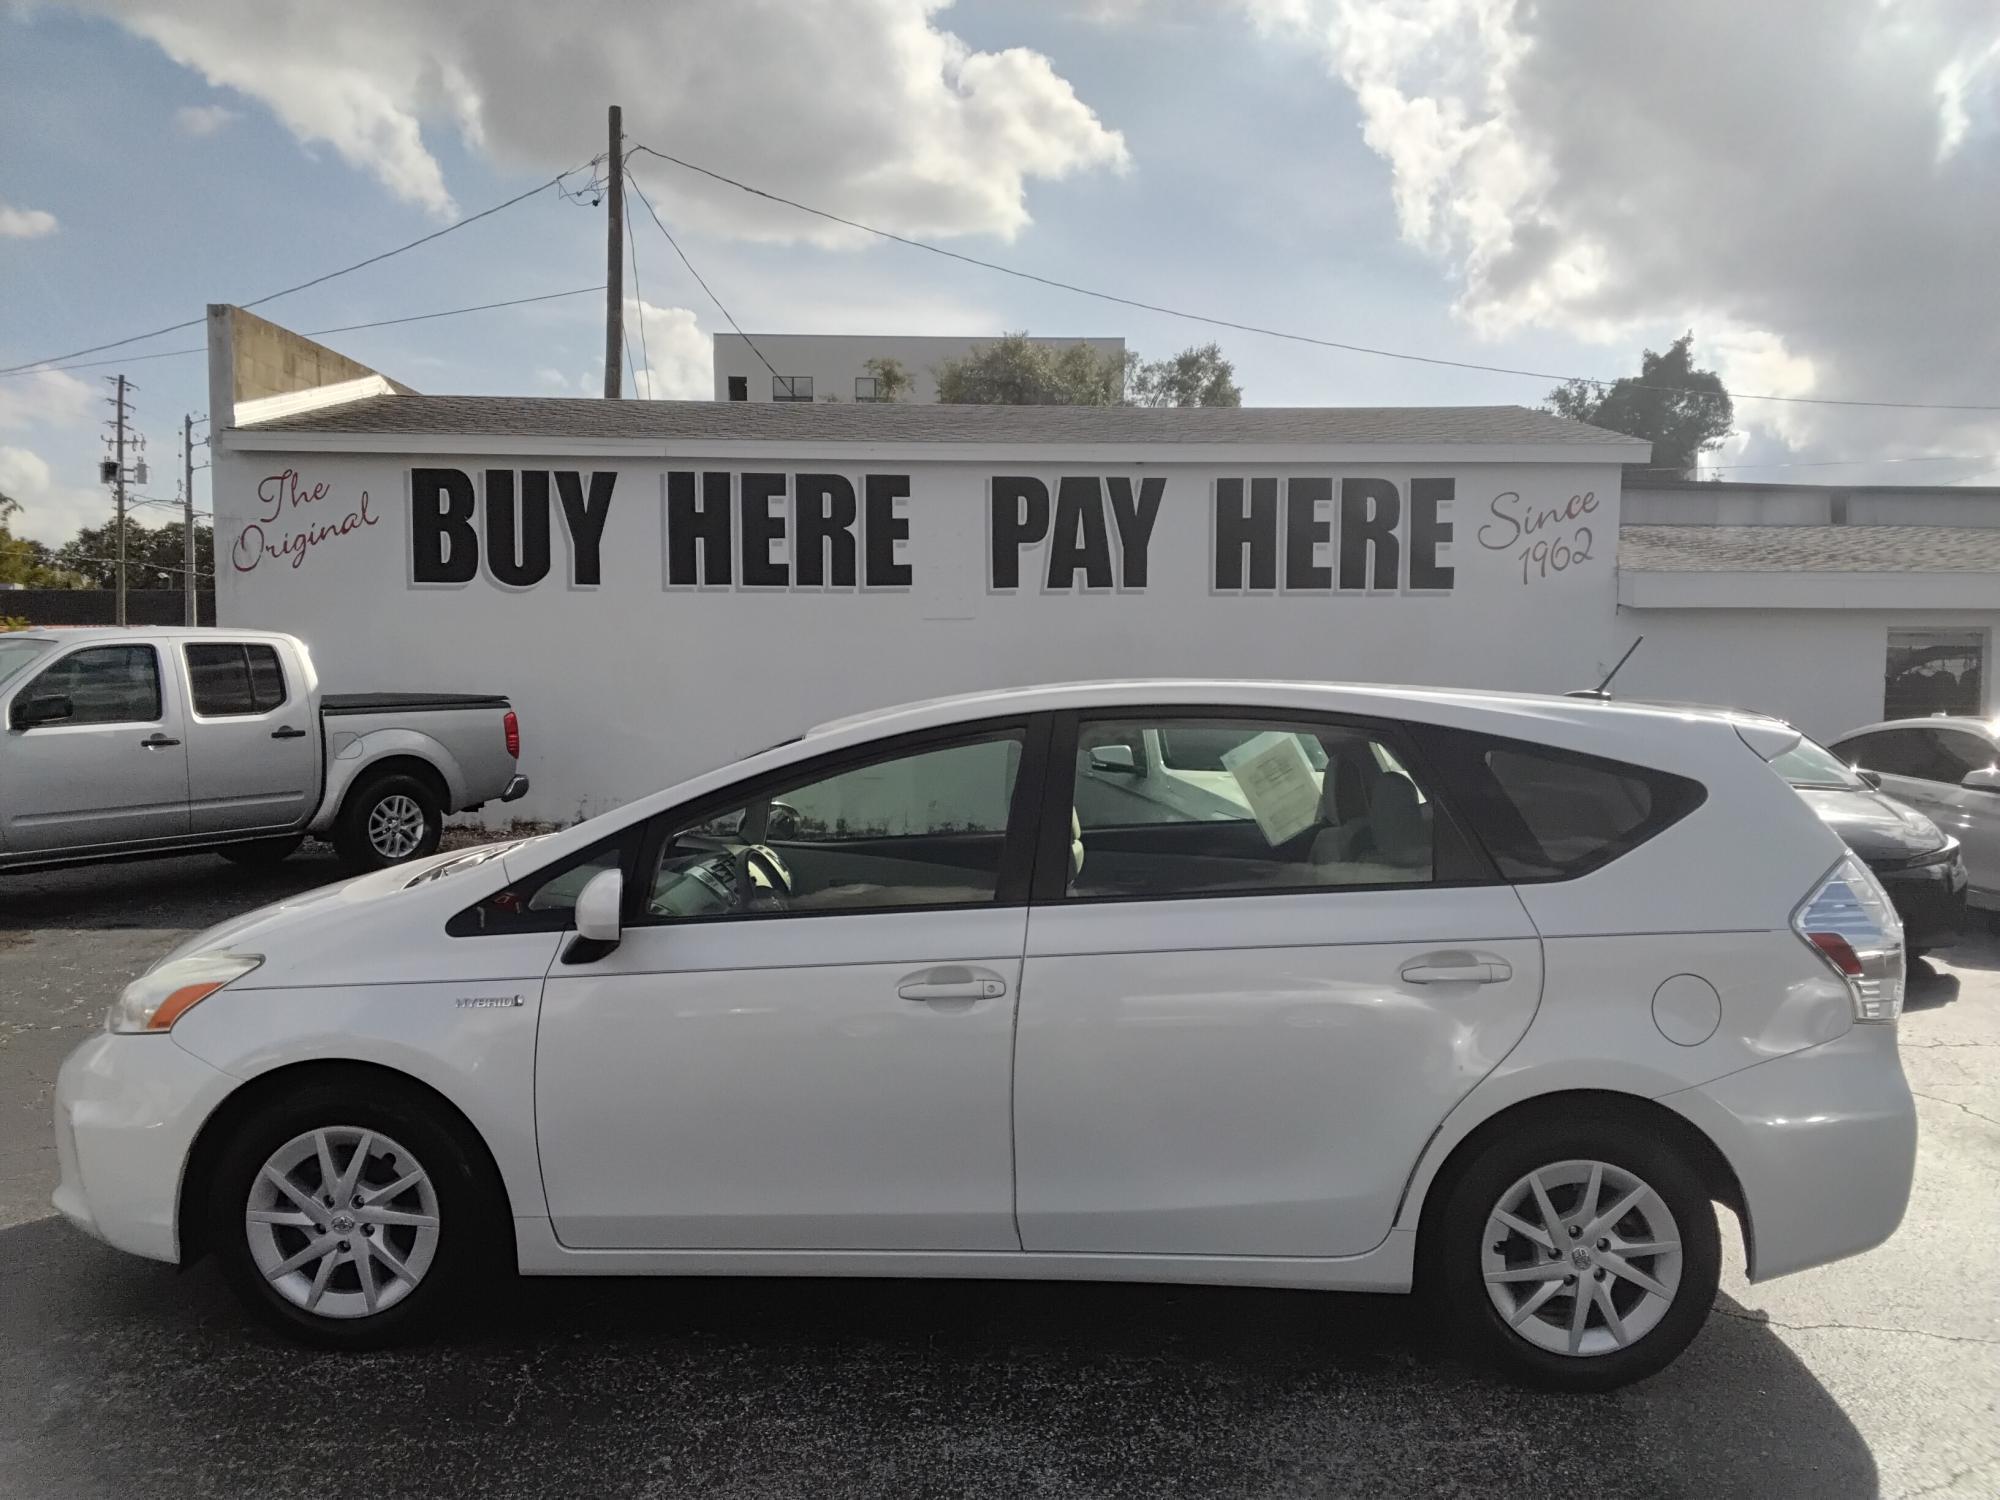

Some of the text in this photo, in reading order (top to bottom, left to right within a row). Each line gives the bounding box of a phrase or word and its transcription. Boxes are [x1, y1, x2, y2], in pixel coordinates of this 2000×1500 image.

[257, 468, 330, 523] The
[1477, 491, 1600, 551] Since
[231, 490, 380, 572] Original
[409, 467, 1456, 590] BUY HERE PAY HERE
[1518, 526, 1596, 586] 1962
